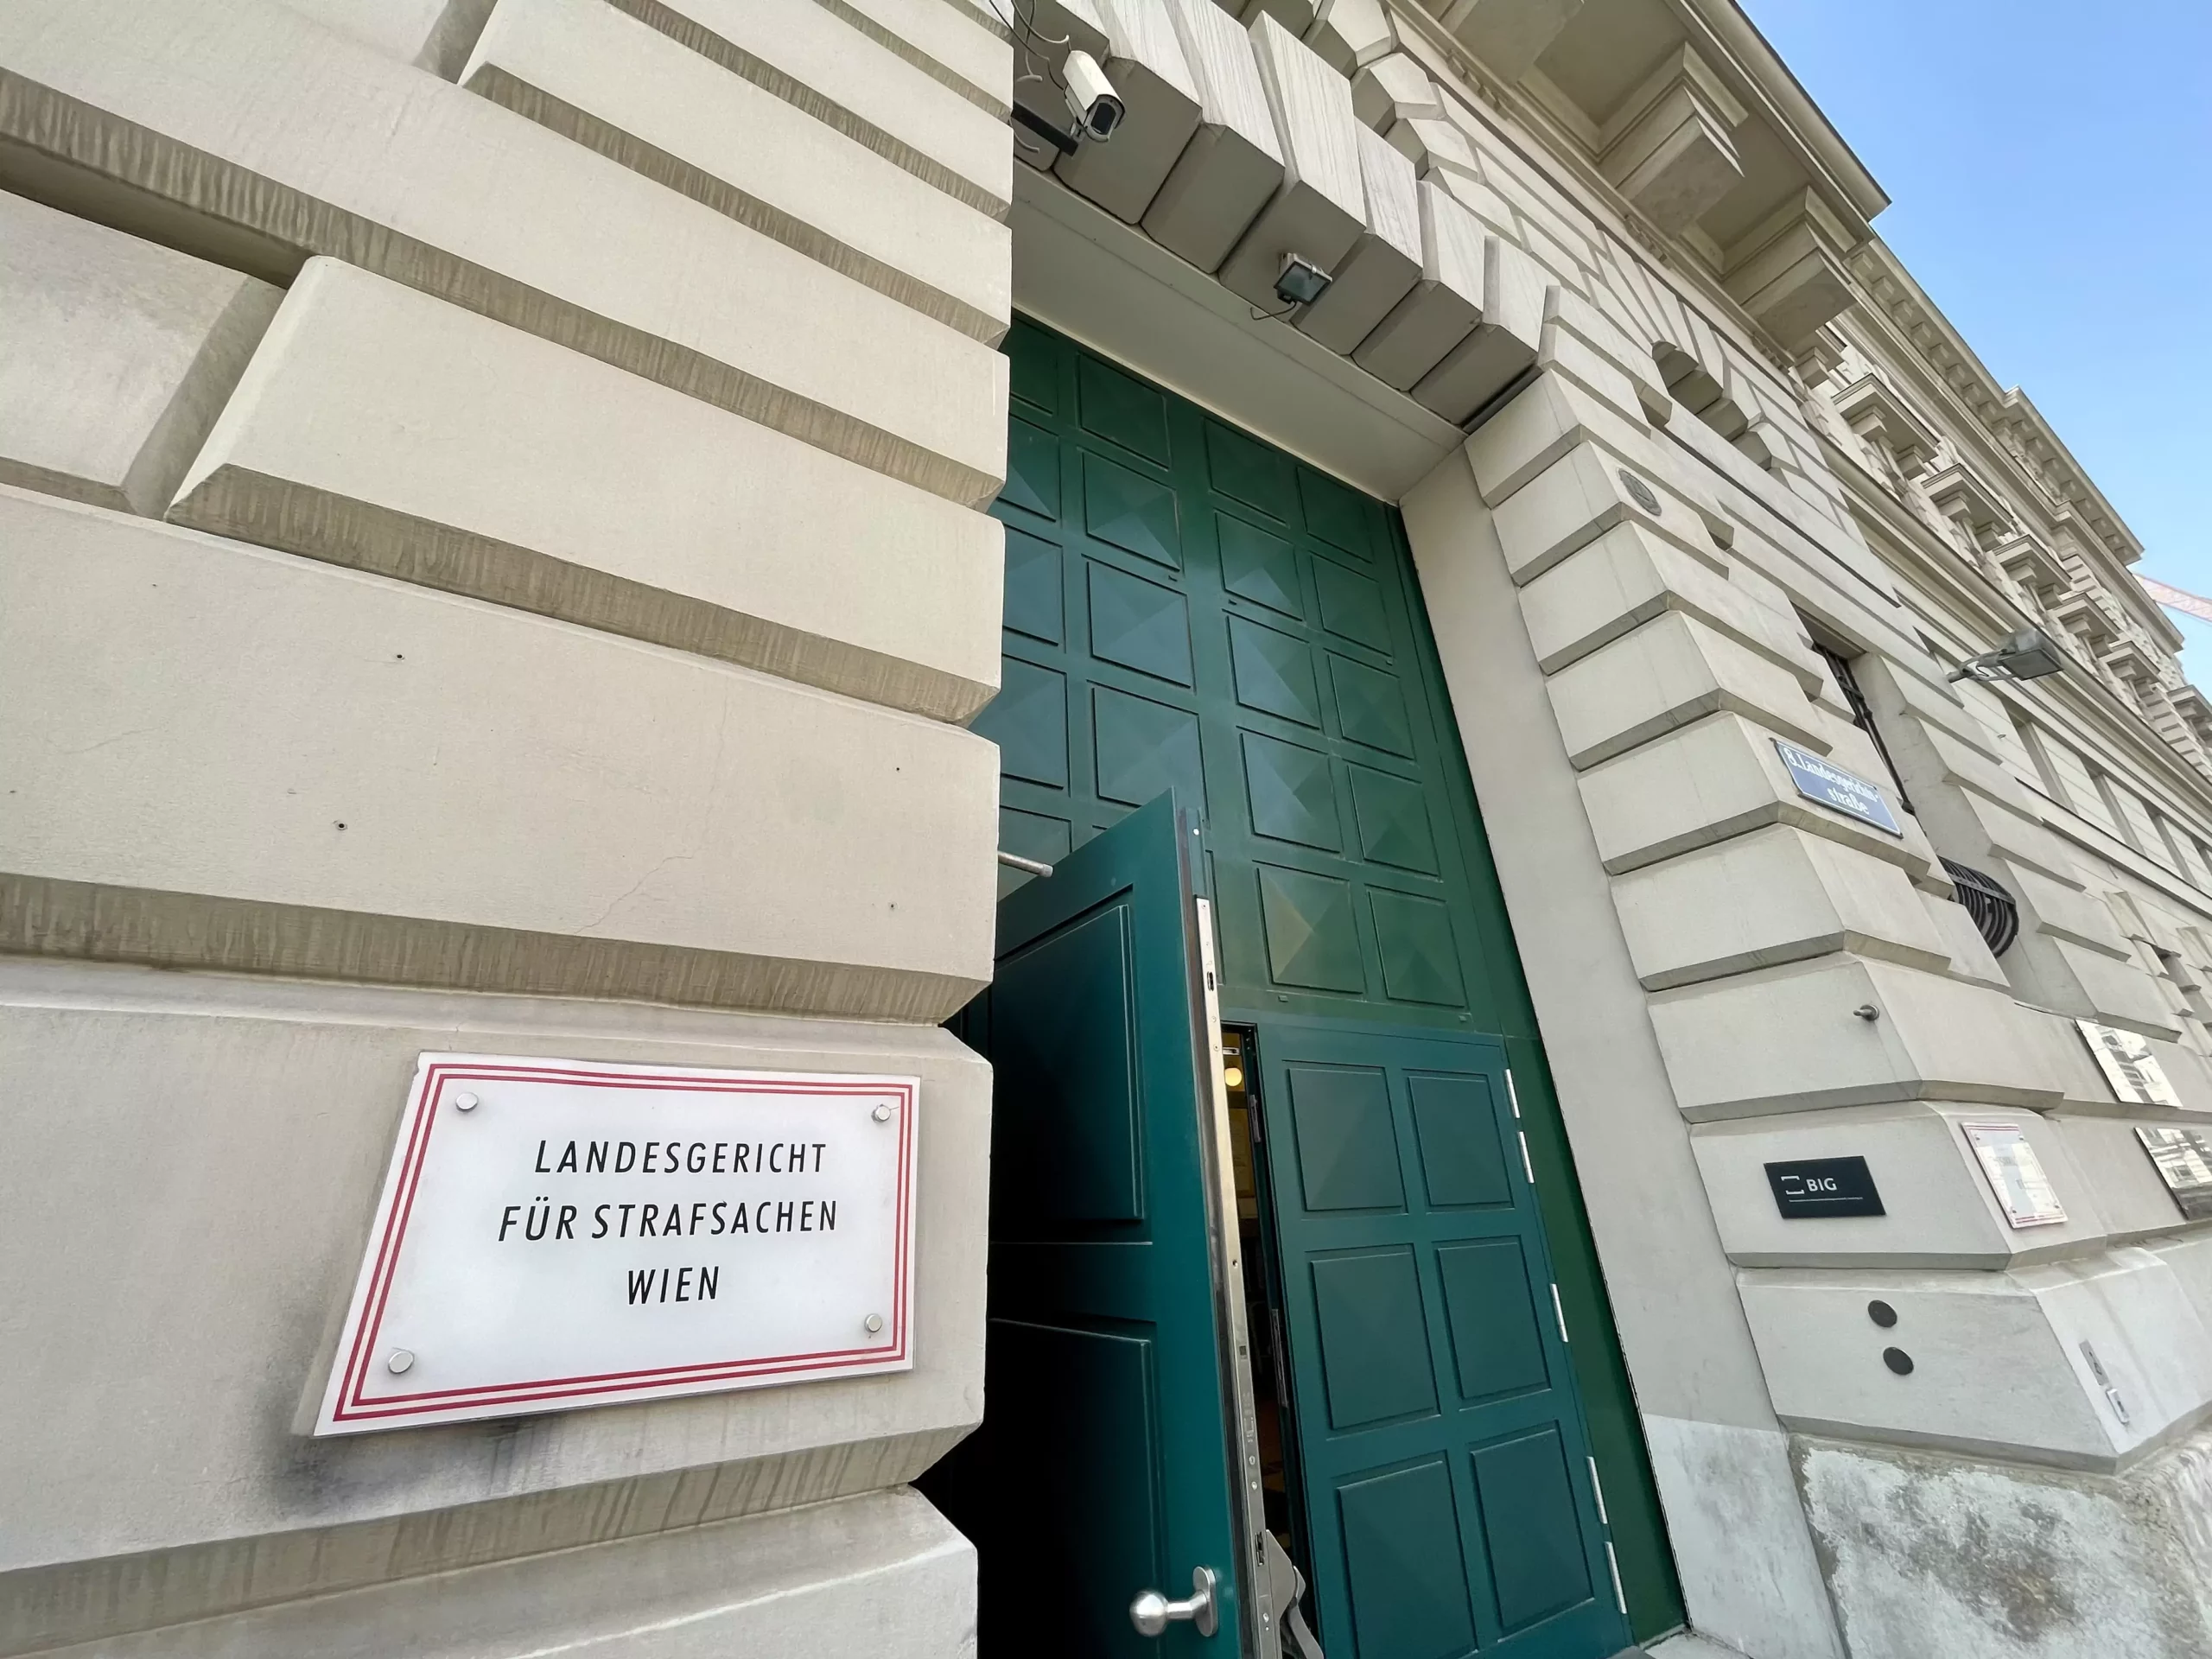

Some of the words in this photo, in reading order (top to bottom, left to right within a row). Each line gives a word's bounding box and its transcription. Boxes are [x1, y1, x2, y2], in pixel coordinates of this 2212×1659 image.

[1827, 787, 1870, 815] straße
[535, 1139, 827, 1173] LANDESGERICHT
[1806, 1178, 1838, 1192] BIG
[498, 1196, 576, 1242] FÜR
[591, 1200, 838, 1238] STRAFSACHEN
[627, 1266, 720, 1306] WIEN
